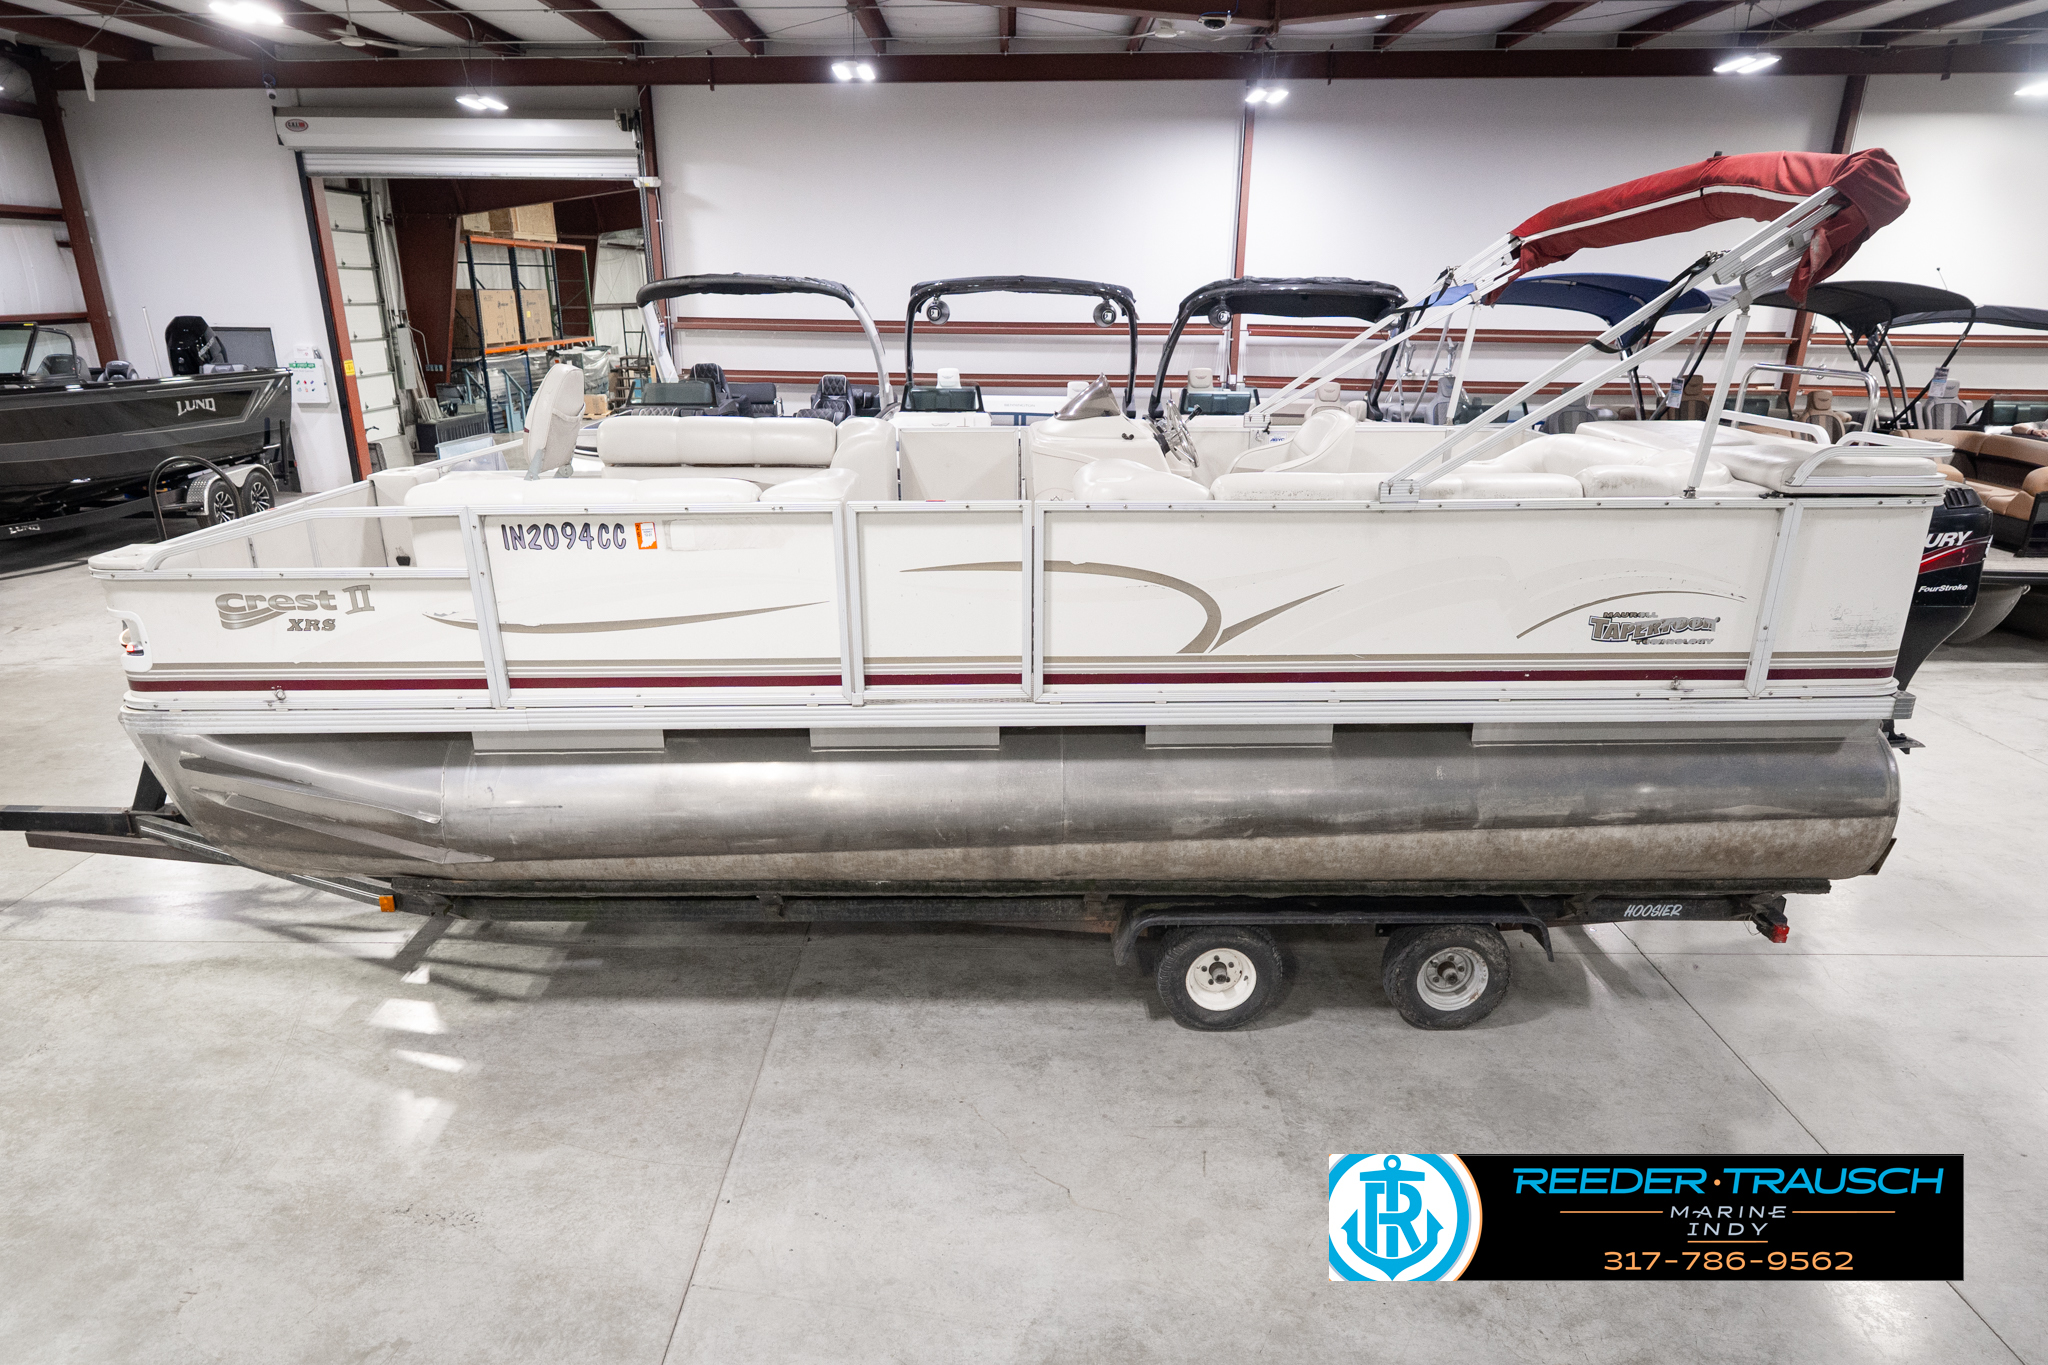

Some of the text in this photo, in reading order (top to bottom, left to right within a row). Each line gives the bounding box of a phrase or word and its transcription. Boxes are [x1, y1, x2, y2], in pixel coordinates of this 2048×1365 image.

[176, 398, 216, 416] LUND
[501, 521, 627, 550] IN2094CC
[1918, 584, 1968, 593] FourStroke
[215, 584, 376, 616] Crest II
[287, 618, 336, 632] XRS
[1623, 904, 1683, 918] HOOSIER
